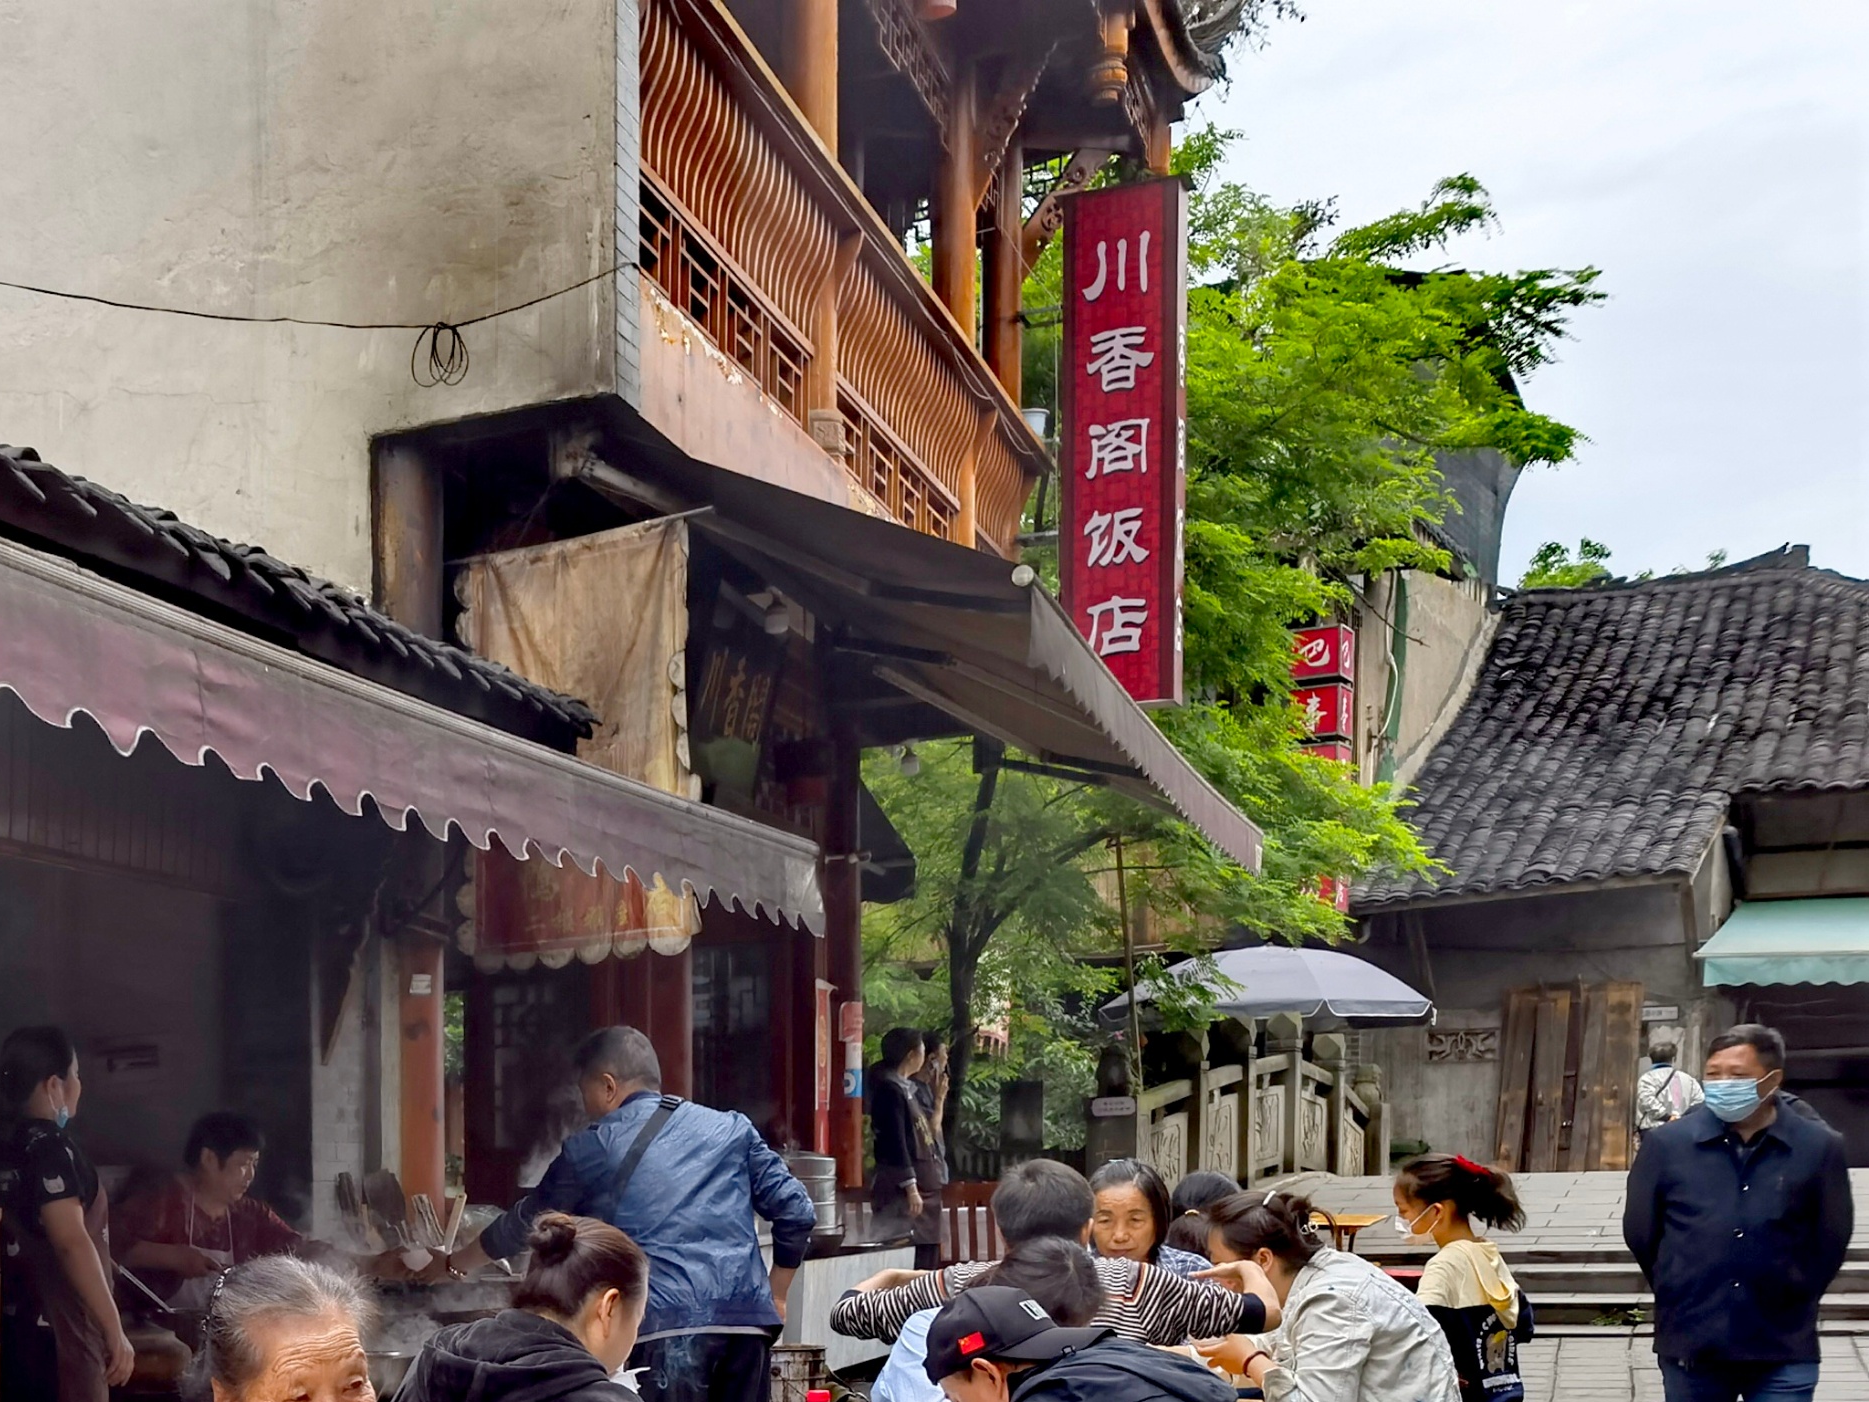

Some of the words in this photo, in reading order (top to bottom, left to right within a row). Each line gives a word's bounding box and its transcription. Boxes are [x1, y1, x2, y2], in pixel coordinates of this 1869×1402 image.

[1082, 230, 1156, 658] 川香阁饭店
